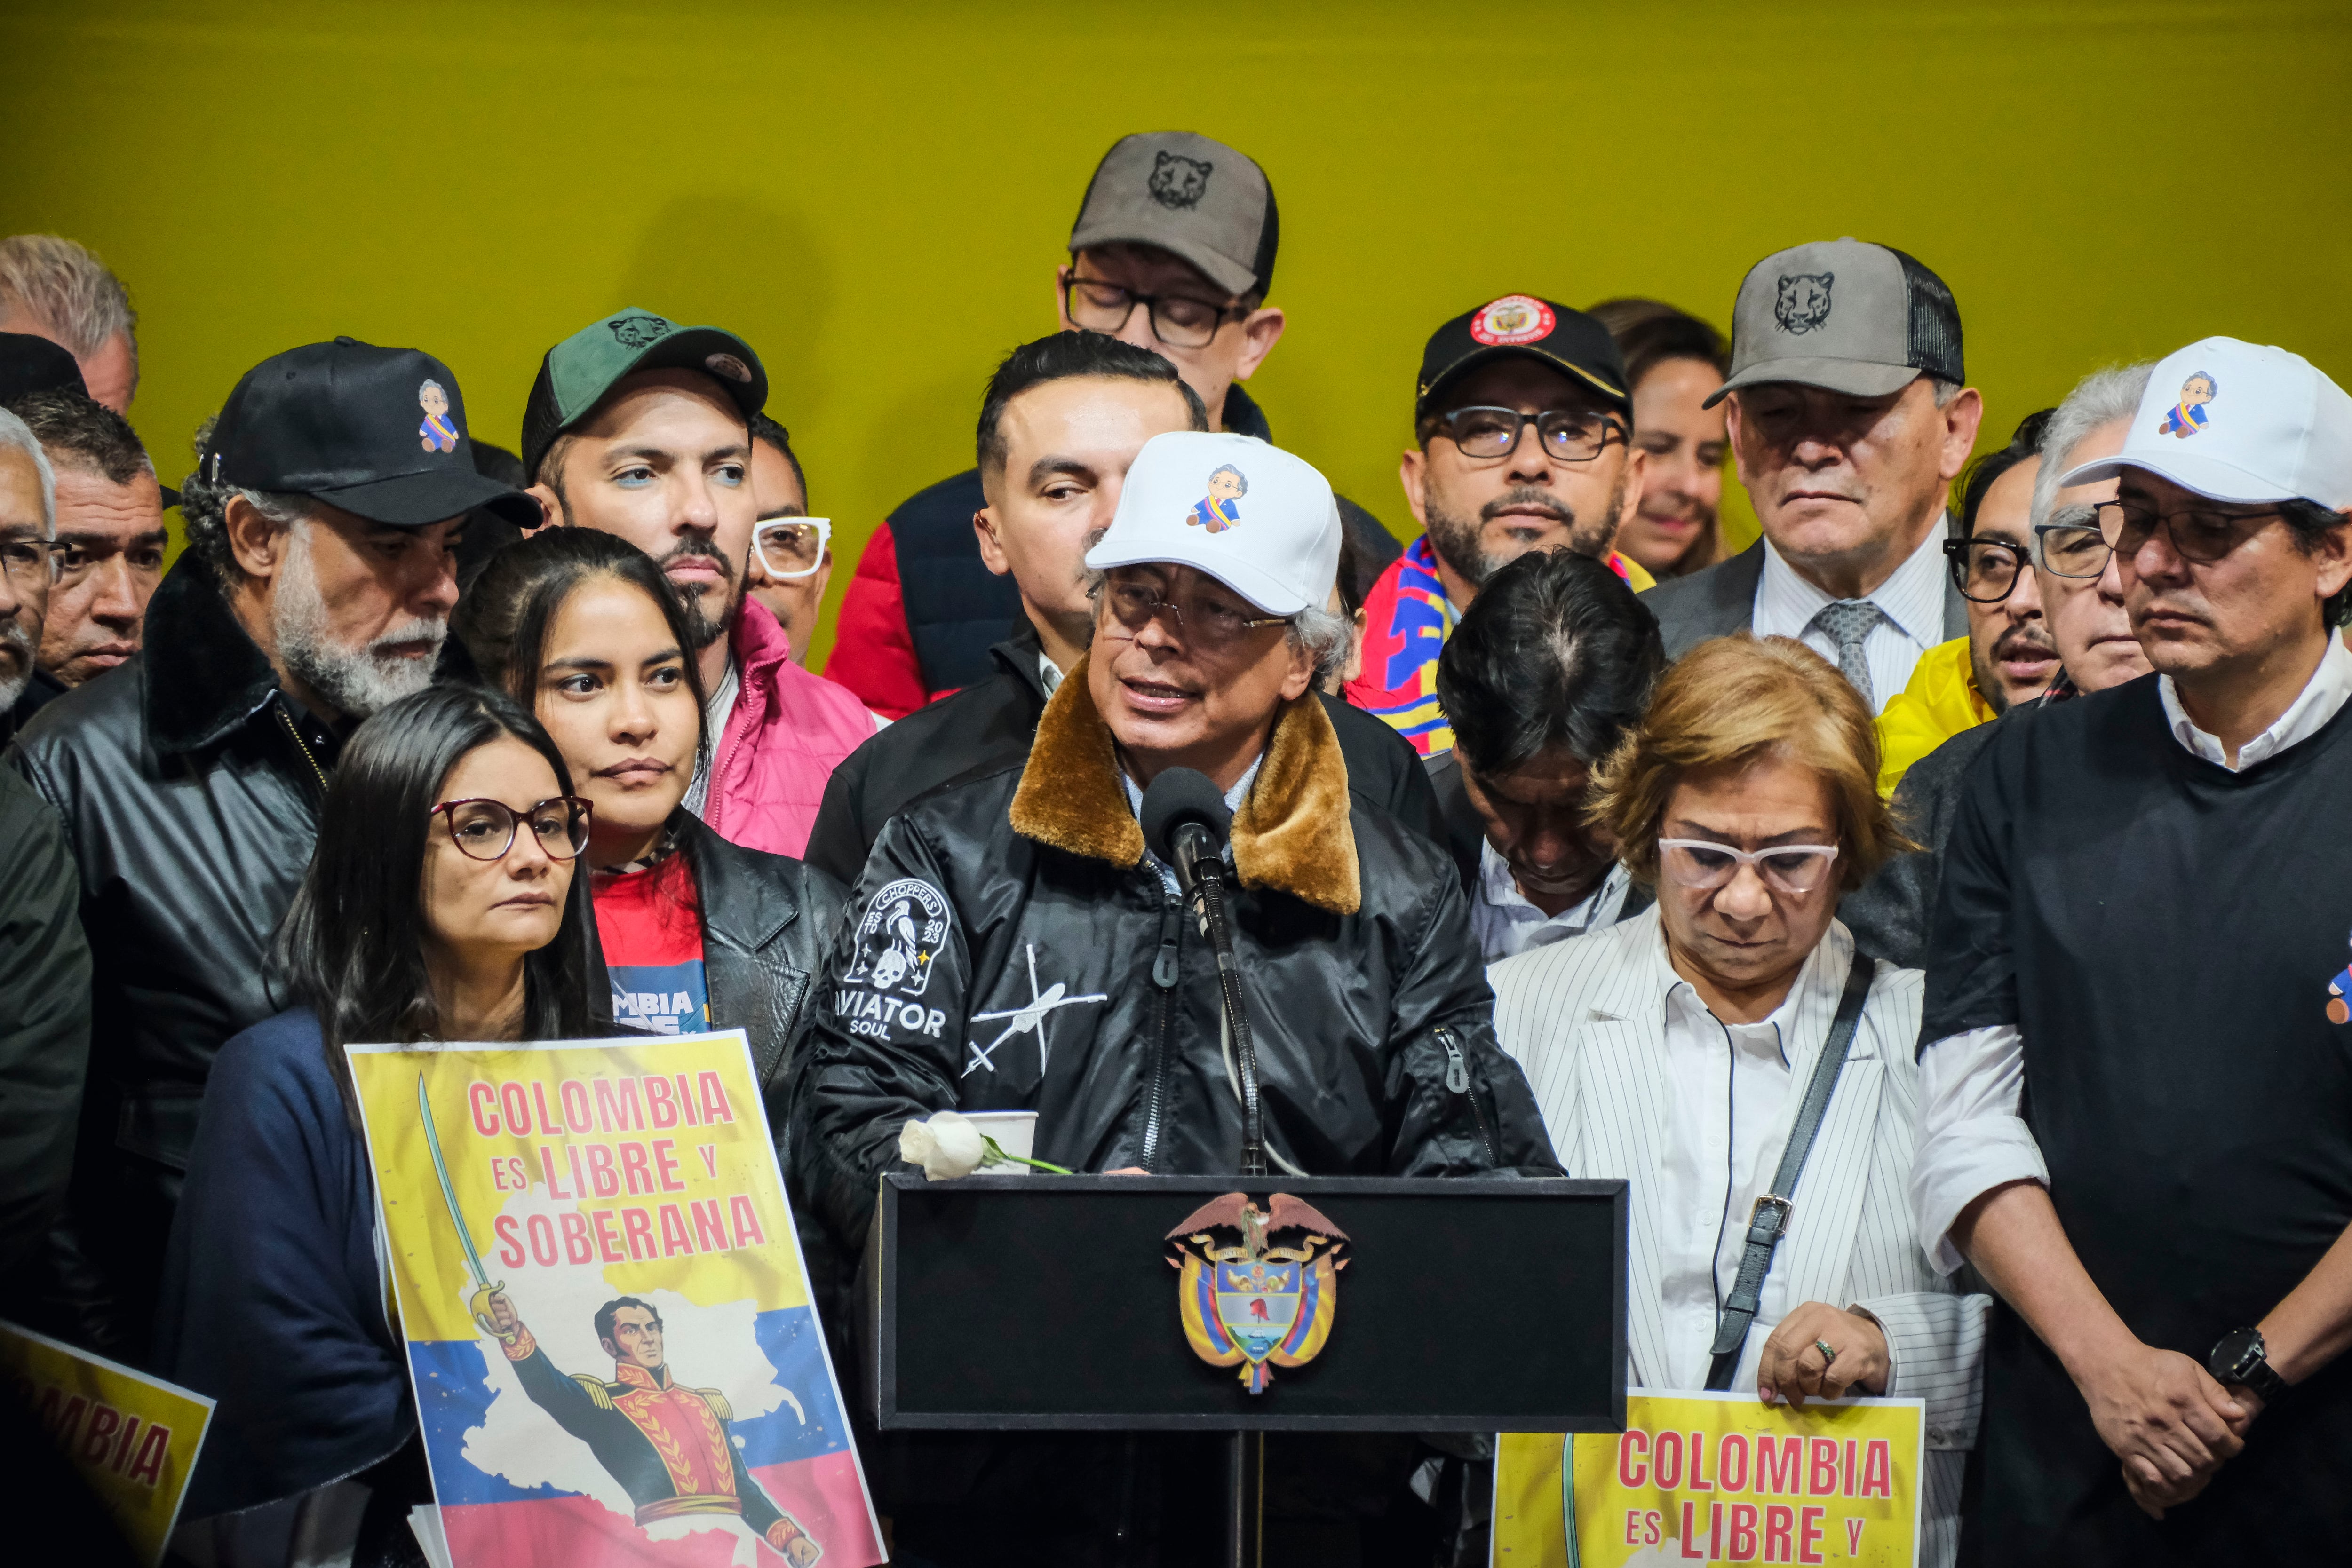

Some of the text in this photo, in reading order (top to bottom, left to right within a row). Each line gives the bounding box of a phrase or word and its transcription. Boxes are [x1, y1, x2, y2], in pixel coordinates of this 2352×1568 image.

[882, 884, 937, 911] CHOPPERS
[864, 922, 878, 934] TD
[867, 912, 882, 923] ES
[925, 919, 943, 932] 20
[922, 931, 940, 944] 23
[850, 1019, 891, 1042] SOUL
[470, 1071, 733, 1136] COLOMBIA
[492, 1140, 717, 1200] ES LIBRE Y
[494, 1196, 765, 1268] SOBERANA
[1619, 1430, 1891, 1497] COLOMBIA
[1626, 1501, 1864, 1563] ES LIBRE Y
